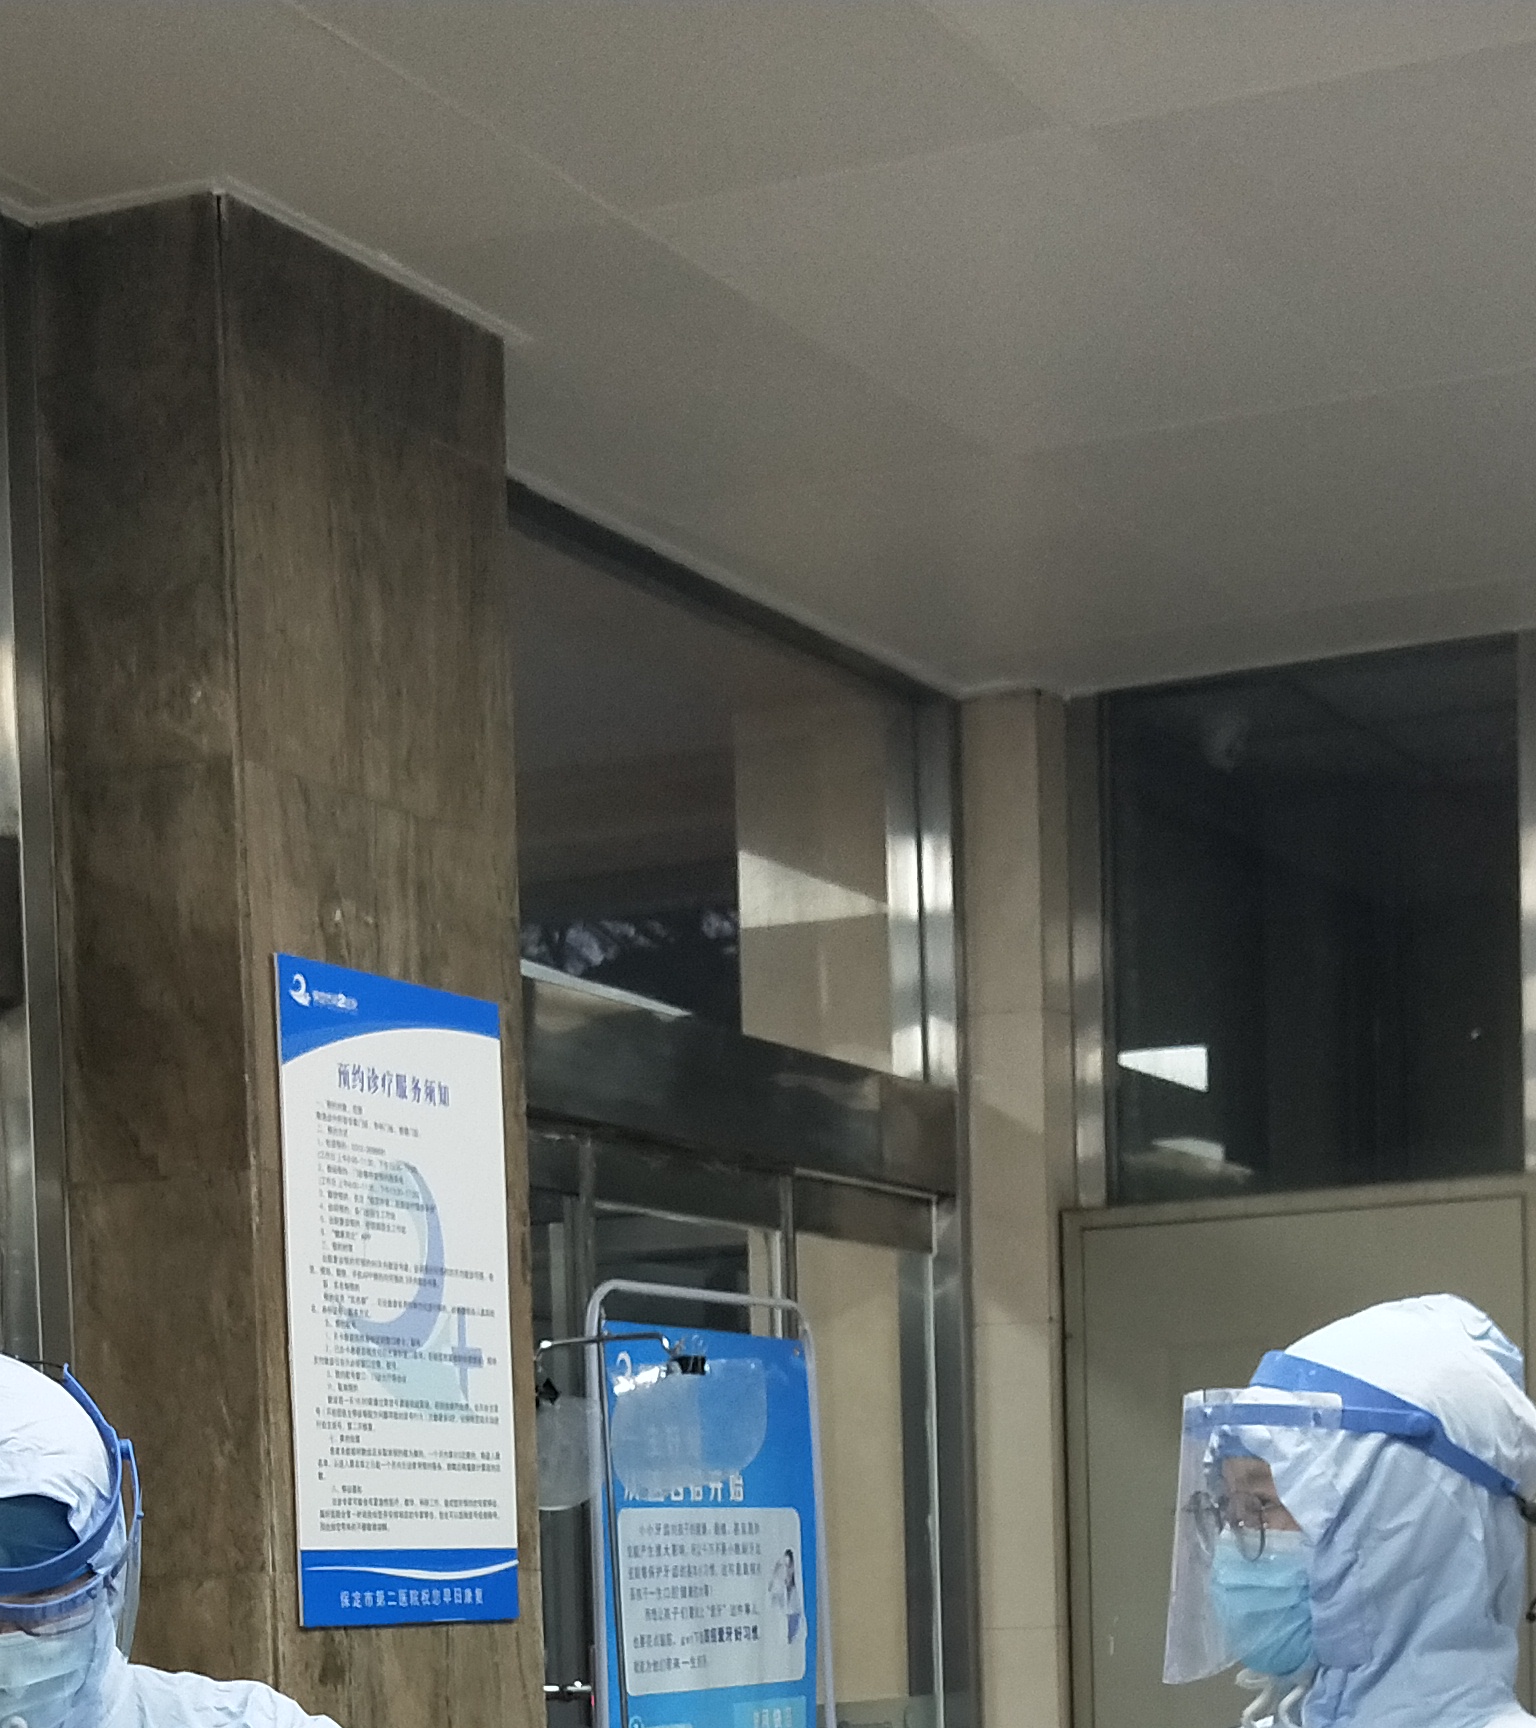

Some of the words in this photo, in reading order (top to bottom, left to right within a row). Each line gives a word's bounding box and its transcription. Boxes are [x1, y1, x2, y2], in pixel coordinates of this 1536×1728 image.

[336, 1062, 451, 1108] 预约诊疗服务须知
[340, 1587, 483, 1608] 保定市第二医院祝您早日康复
